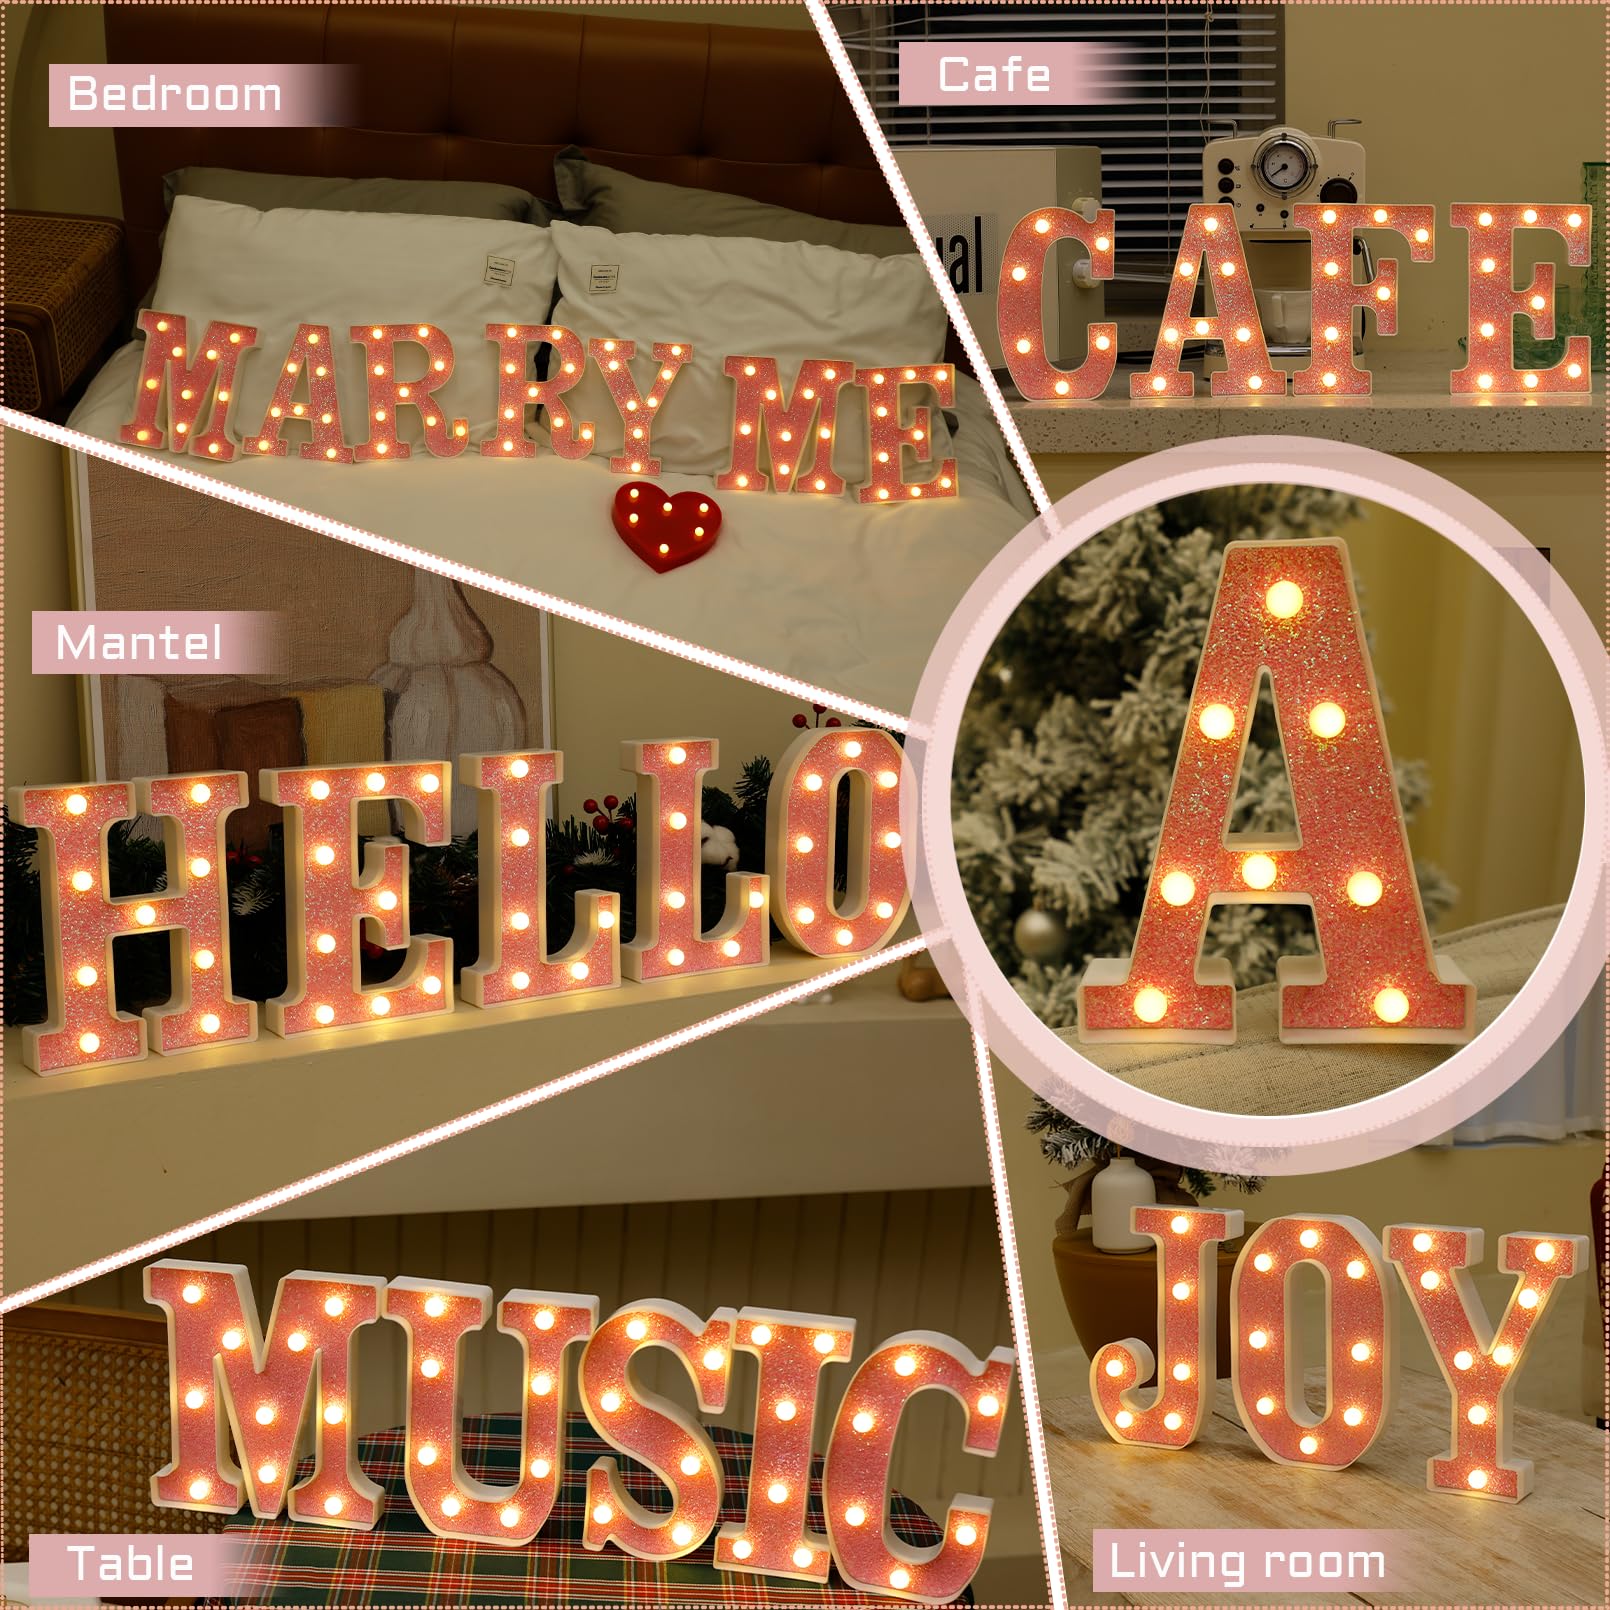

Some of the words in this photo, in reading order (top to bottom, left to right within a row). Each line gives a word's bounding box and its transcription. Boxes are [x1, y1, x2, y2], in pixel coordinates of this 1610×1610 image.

[120, 308, 693, 476] MARRY
[715, 355, 960, 504] ME
[997, 203, 1593, 401] CAFE
[9, 727, 916, 1077] HELLO
[1077, 536, 1477, 1045] A
[143, 1258, 1015, 1605] MUSIC
[1089, 1204, 1589, 1503] JOY
